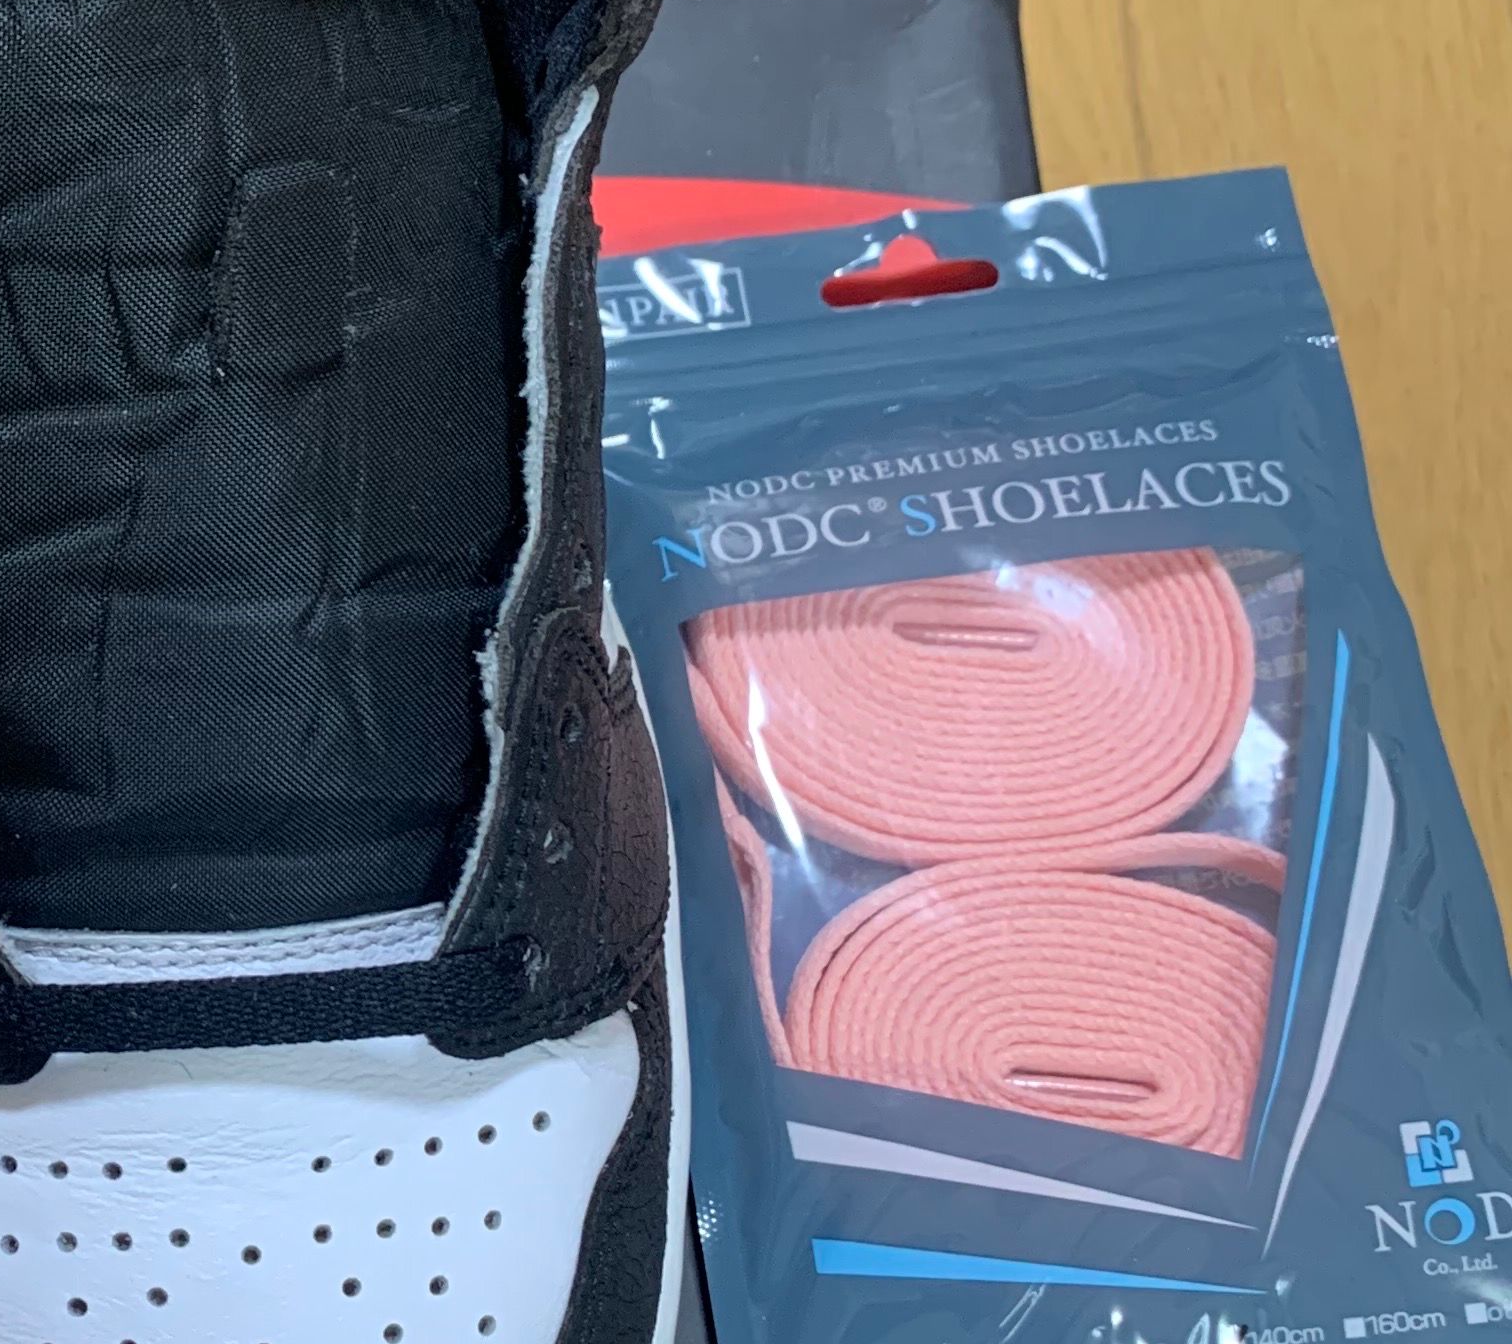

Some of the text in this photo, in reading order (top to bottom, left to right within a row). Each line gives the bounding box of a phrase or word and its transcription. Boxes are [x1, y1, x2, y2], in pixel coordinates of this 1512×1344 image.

[706, 418, 1219, 505] NODC PREMIUM SHOELACES
[899, 460, 1292, 538] SHOELACES
[1461, 1252, 1499, 1273] Ltd.
[1365, 1311, 1446, 1337] 160cm
